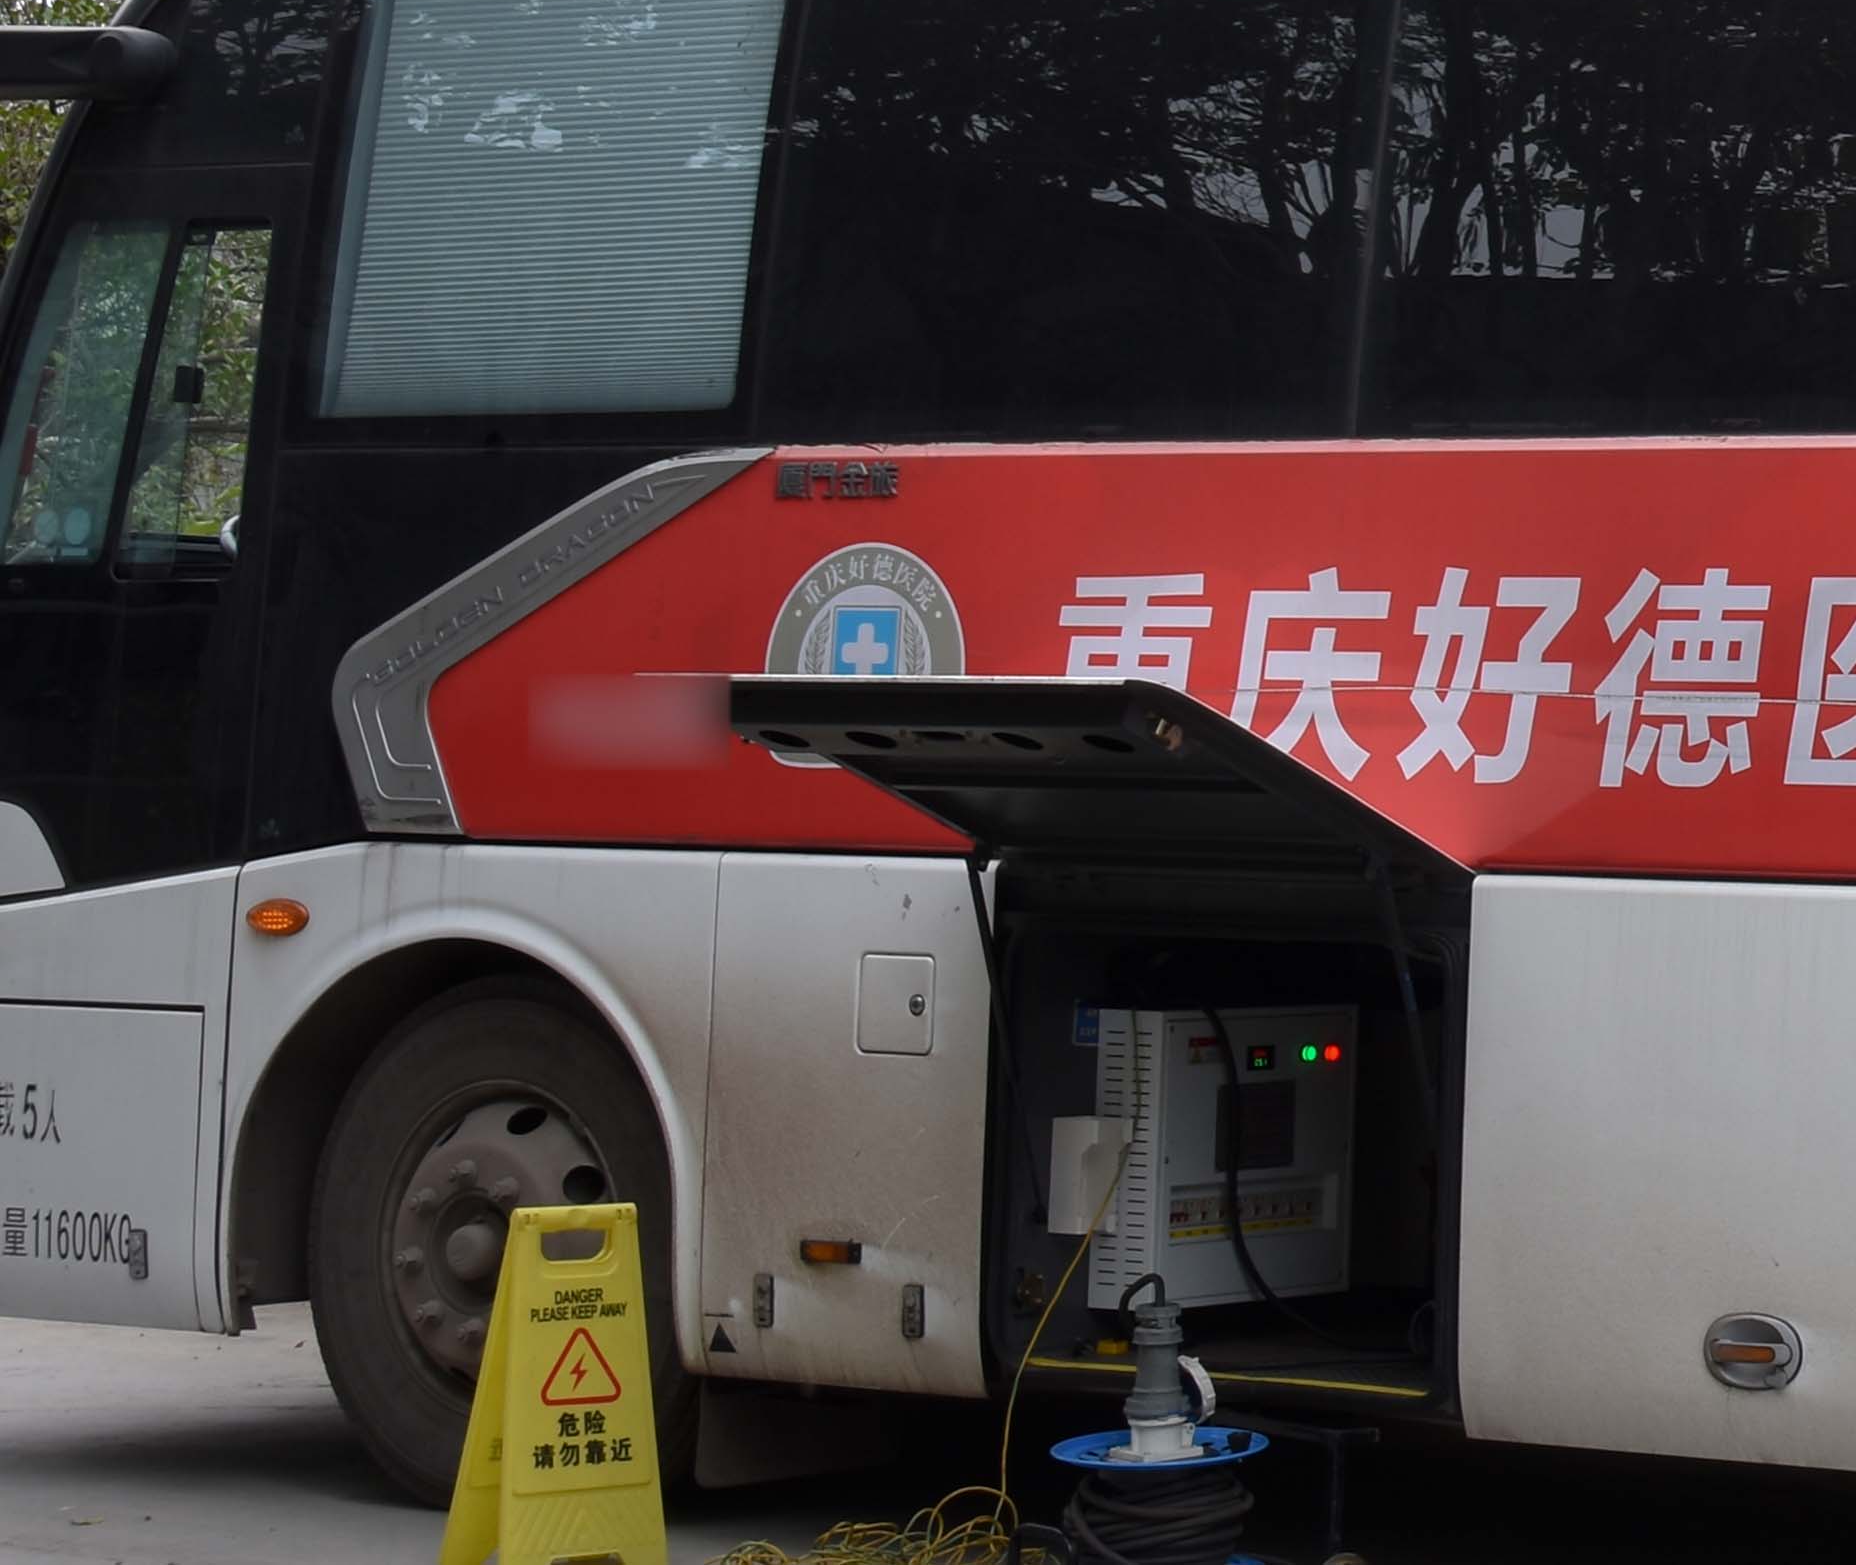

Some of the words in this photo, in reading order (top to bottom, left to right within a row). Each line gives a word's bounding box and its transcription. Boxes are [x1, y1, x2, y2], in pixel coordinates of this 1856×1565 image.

[804, 553, 938, 613] 重庆好德医院
[554, 1288, 603, 1305] DANGER
[530, 1307, 569, 1323] PLEASE
[571, 1304, 597, 1320] KEEP
[600, 1302, 627, 1317] AWAY
[558, 1410, 606, 1437] 危险
[533, 1437, 633, 1469] 请勿靠近
